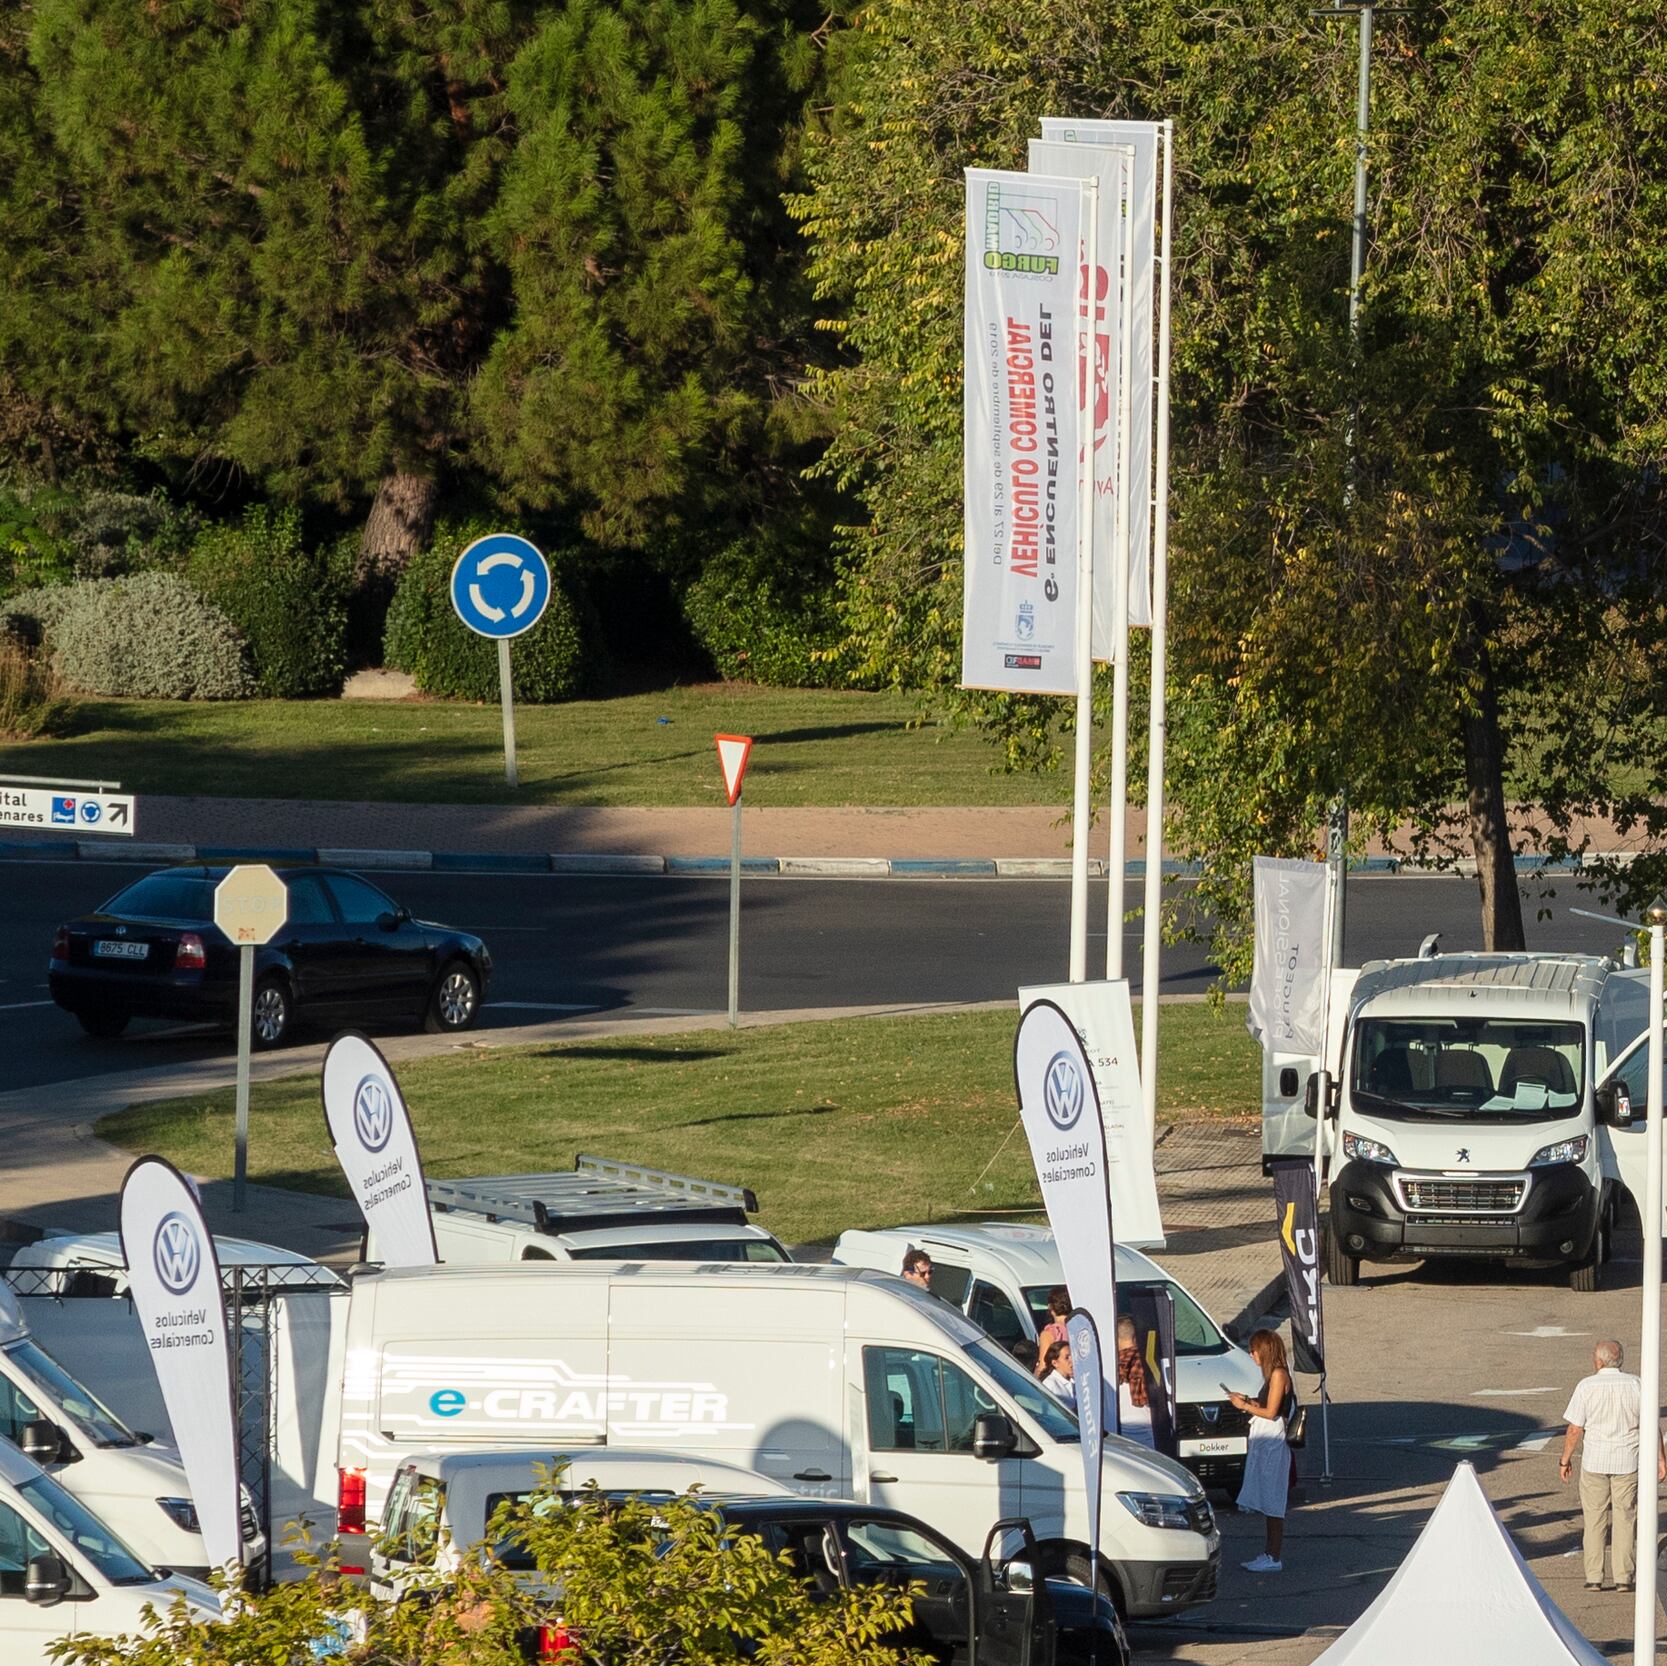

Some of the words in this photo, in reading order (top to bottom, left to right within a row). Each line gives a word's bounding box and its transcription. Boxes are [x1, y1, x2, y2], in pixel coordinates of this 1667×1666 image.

[127, 944, 145, 956] CLL
[1098, 1057, 1118, 1068] 534
[429, 1389, 727, 1422] e-CRAFTER
[1199, 1443, 1229, 1452] Dokker
